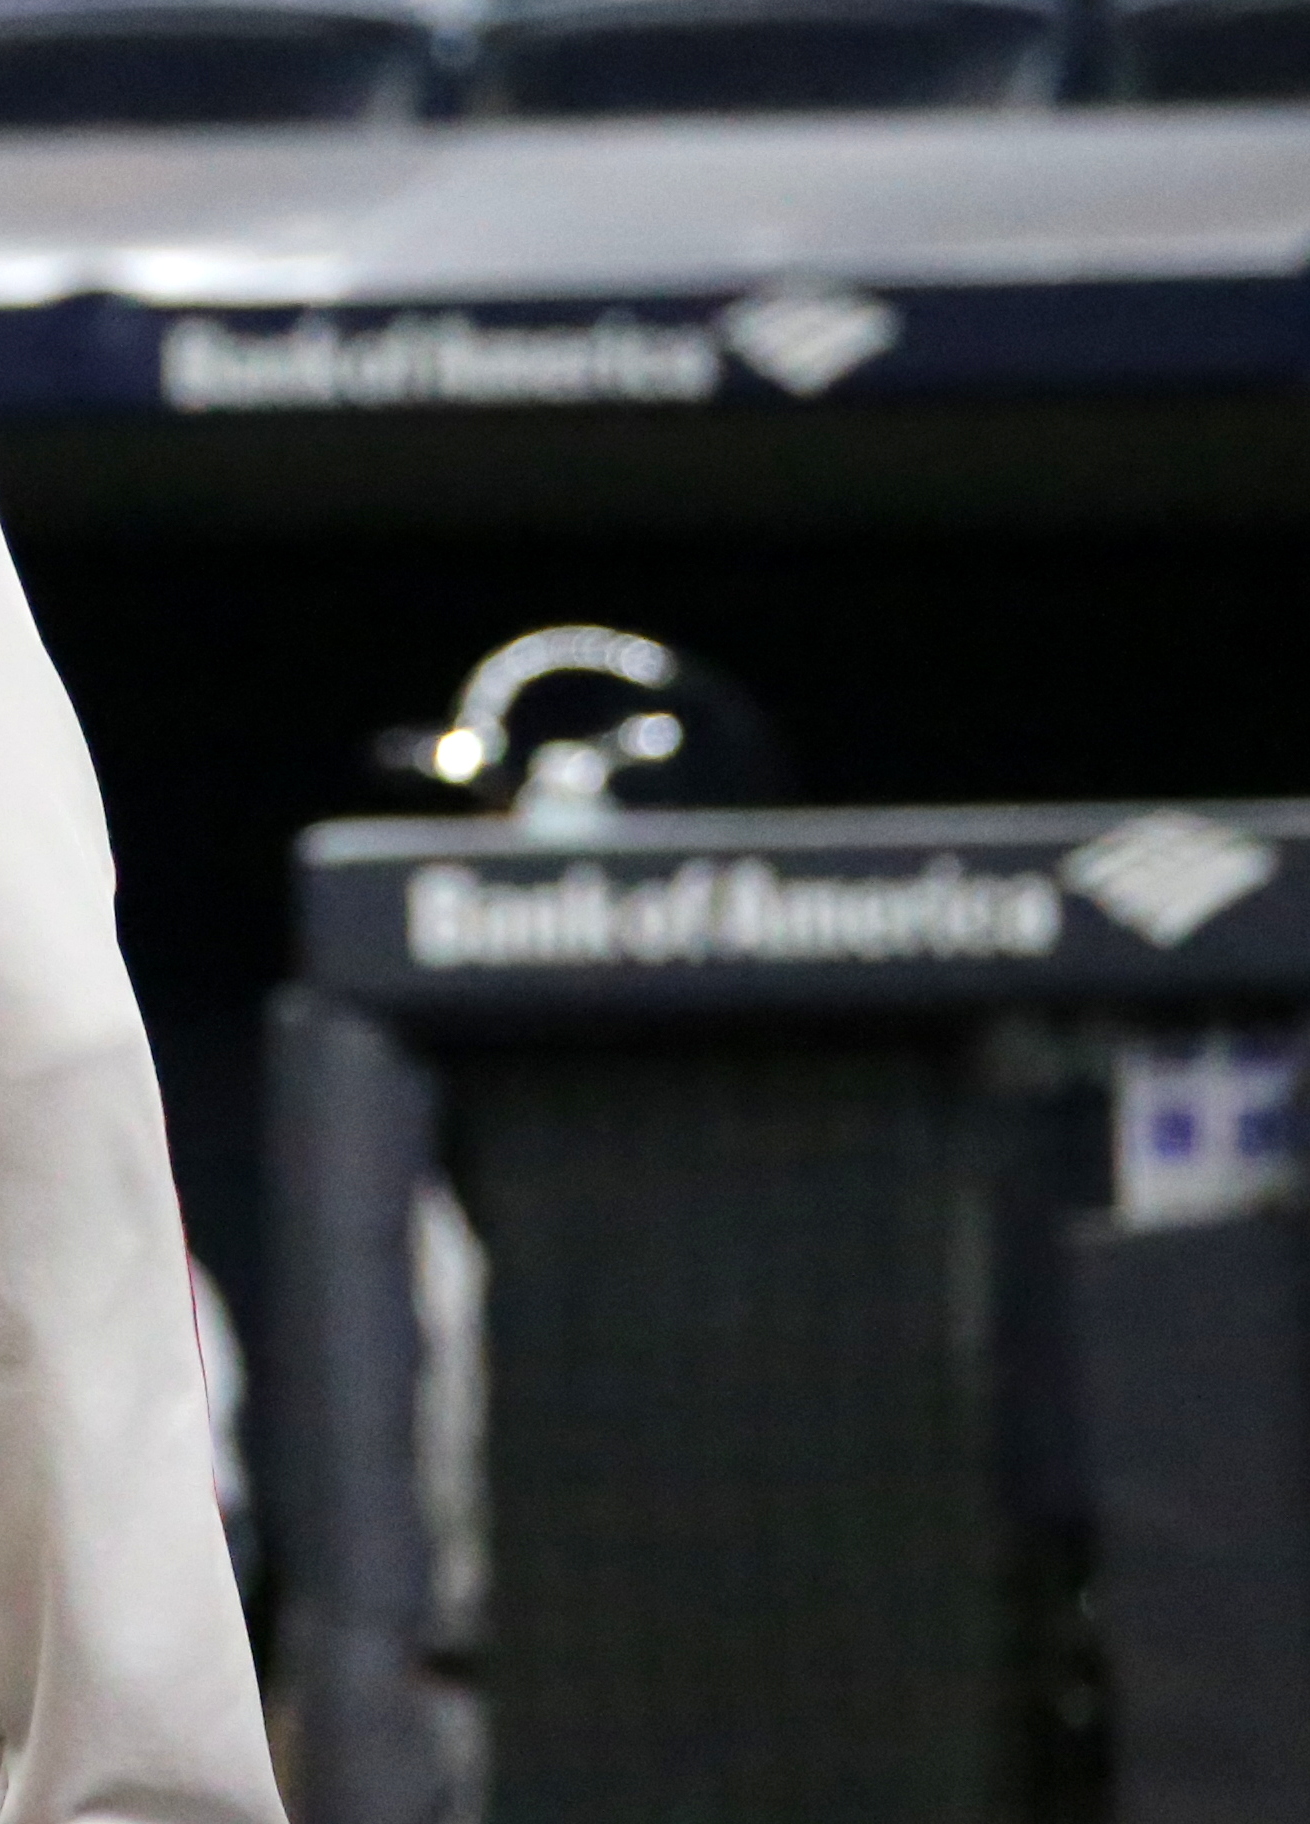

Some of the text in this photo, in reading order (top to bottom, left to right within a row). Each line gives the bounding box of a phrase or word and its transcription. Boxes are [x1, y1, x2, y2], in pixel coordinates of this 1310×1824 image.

[405, 854, 1063, 971] Bank of America
